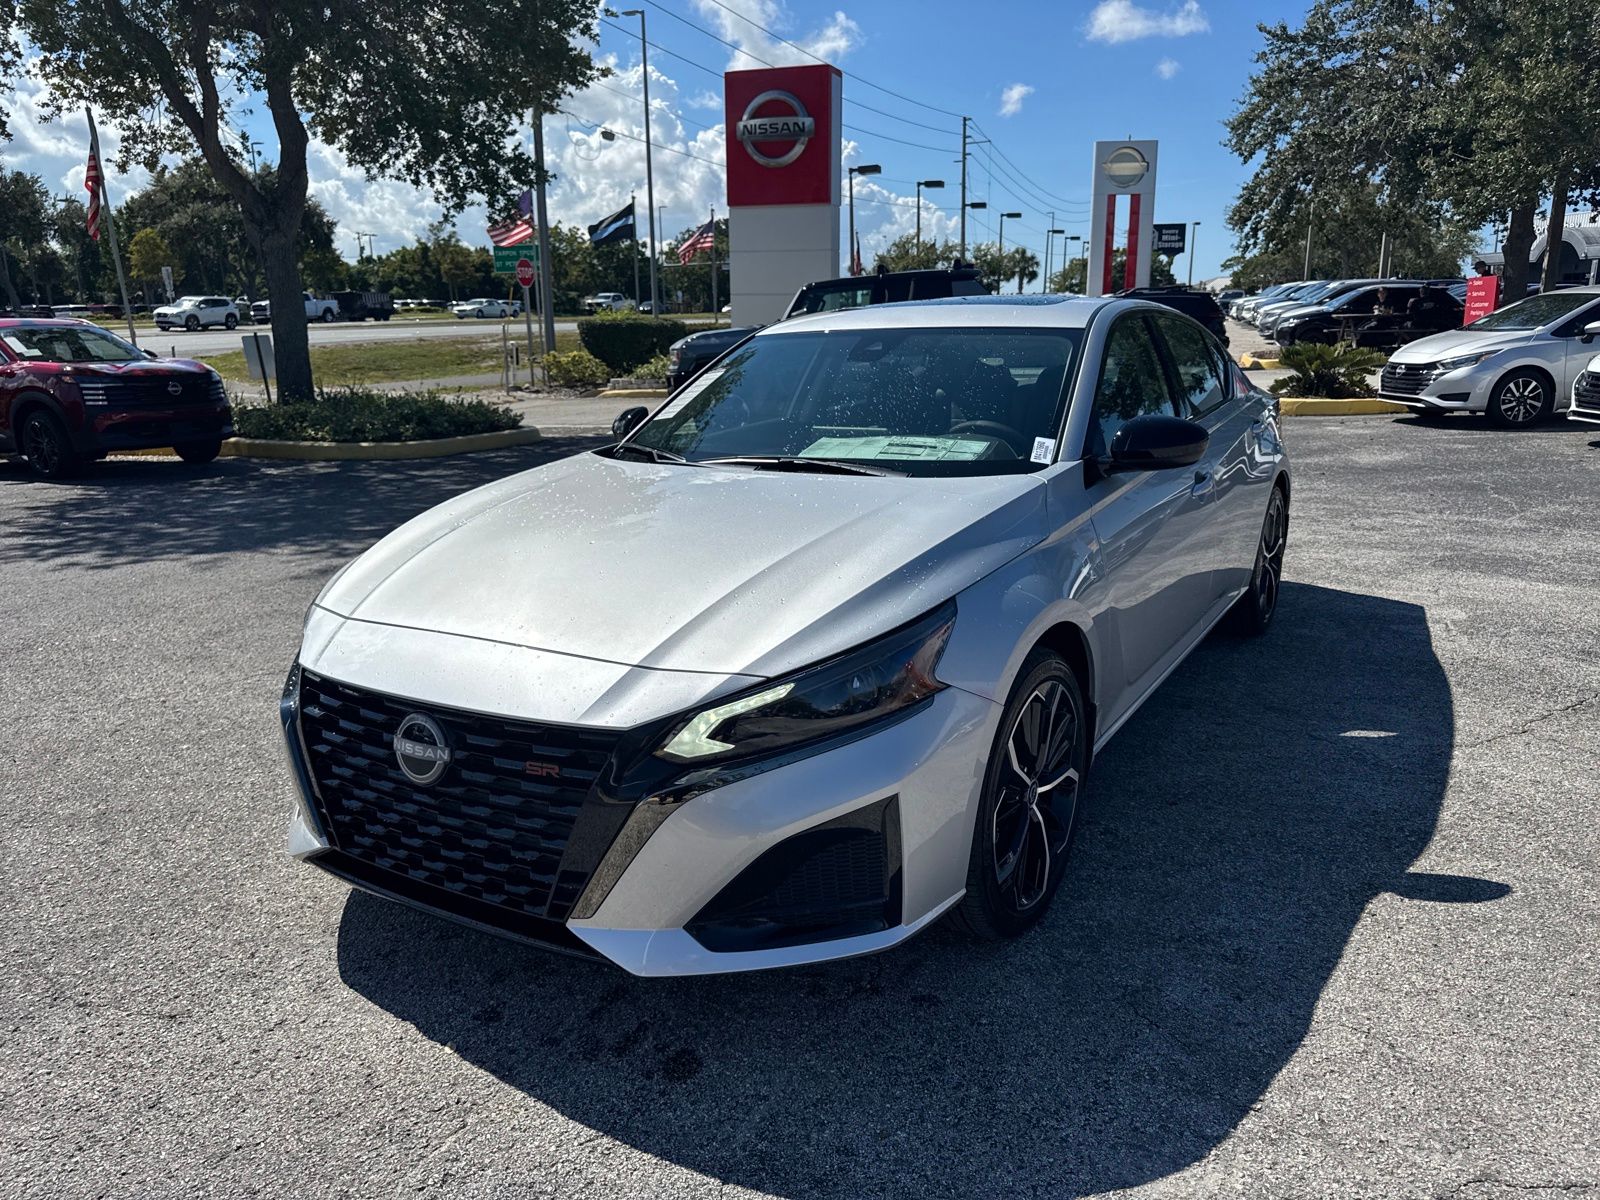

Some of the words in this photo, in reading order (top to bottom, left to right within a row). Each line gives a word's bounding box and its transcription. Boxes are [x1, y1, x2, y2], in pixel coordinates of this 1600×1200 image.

[742, 121, 806, 136] NISSAN
[517, 267, 535, 278] STOP
[393, 738, 449, 760] NISSAN
[525, 761, 560, 778] SR
